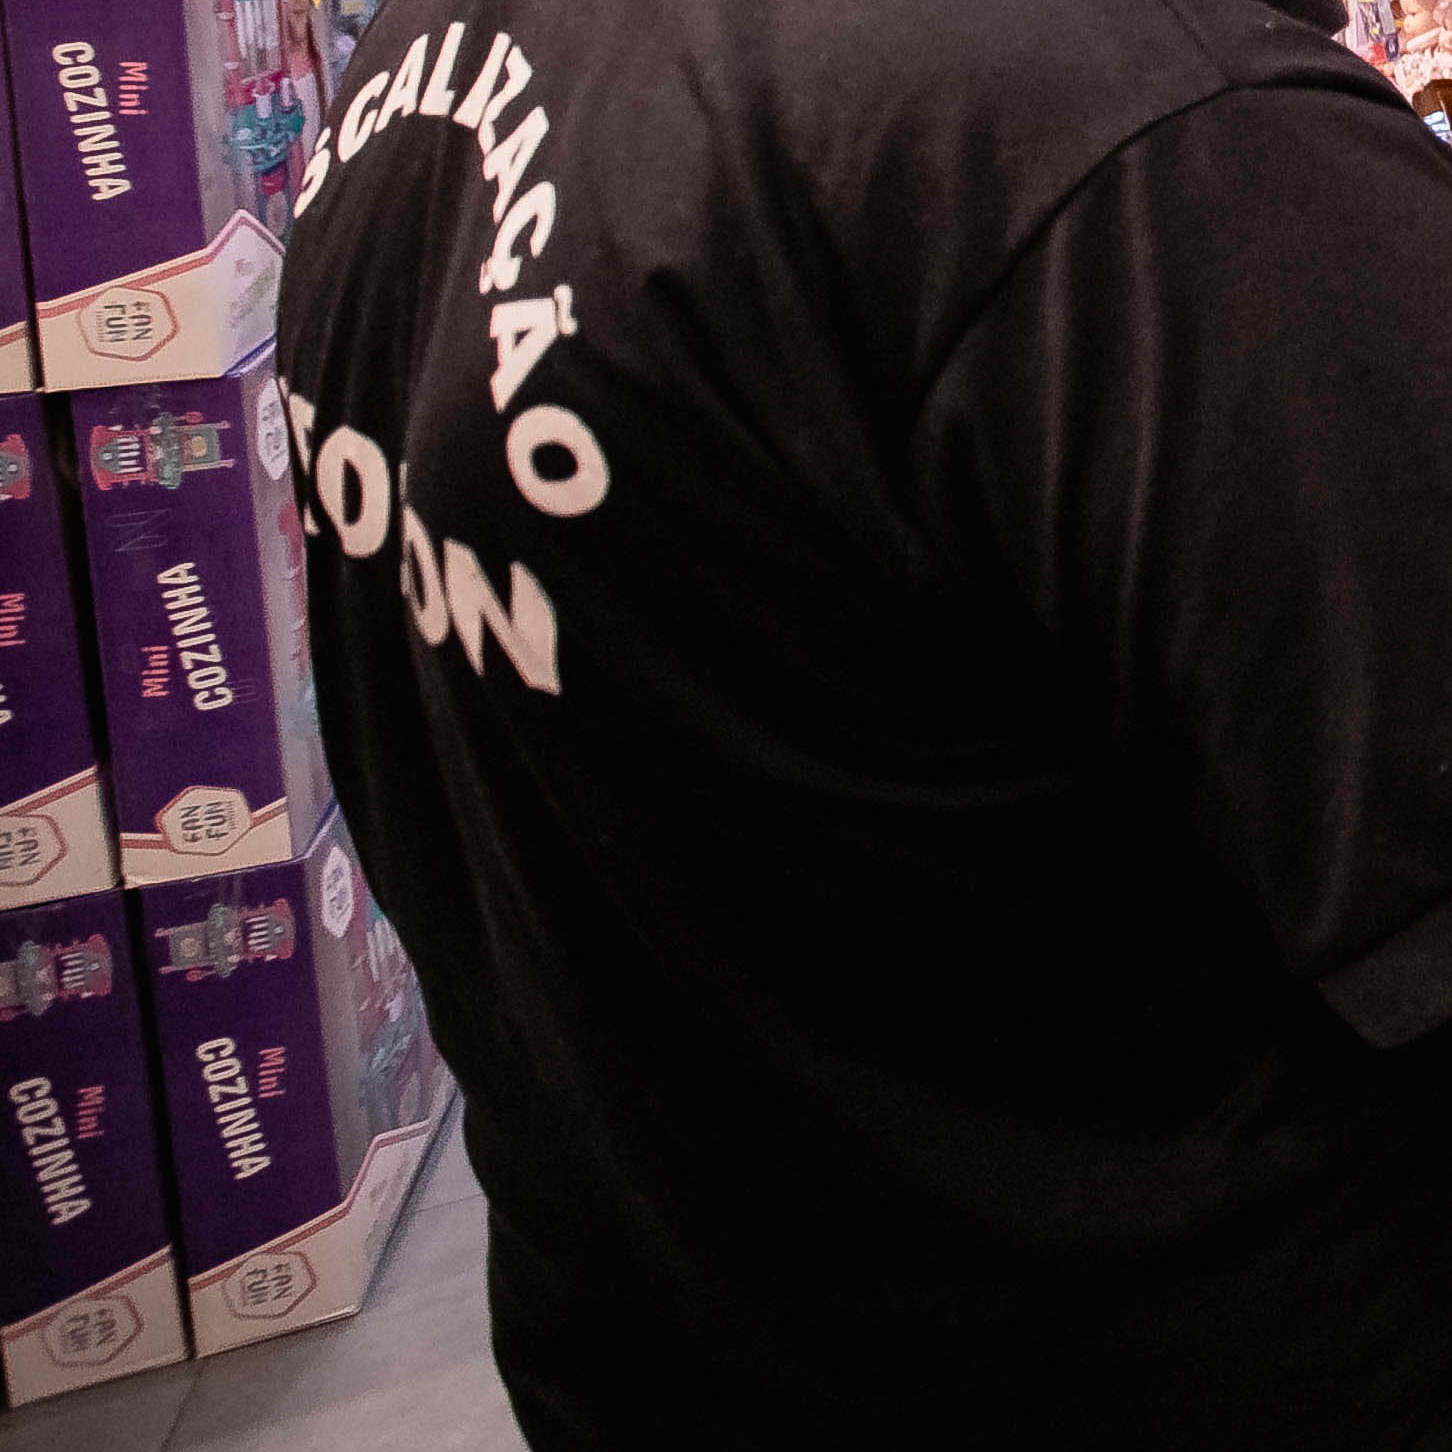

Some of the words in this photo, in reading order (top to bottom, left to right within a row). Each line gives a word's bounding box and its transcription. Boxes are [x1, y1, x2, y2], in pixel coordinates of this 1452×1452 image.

[52, 40, 133, 202] COZINHA
[119, 61, 148, 116] Mini
[141, 644, 170, 698] Mini
[156, 561, 234, 712] COZINHA
[75, 1085, 105, 1140] Mini
[195, 1037, 273, 1181] COZINHA
[257, 1046, 287, 1099] Mini
[7, 1076, 92, 1226] COZINHA
